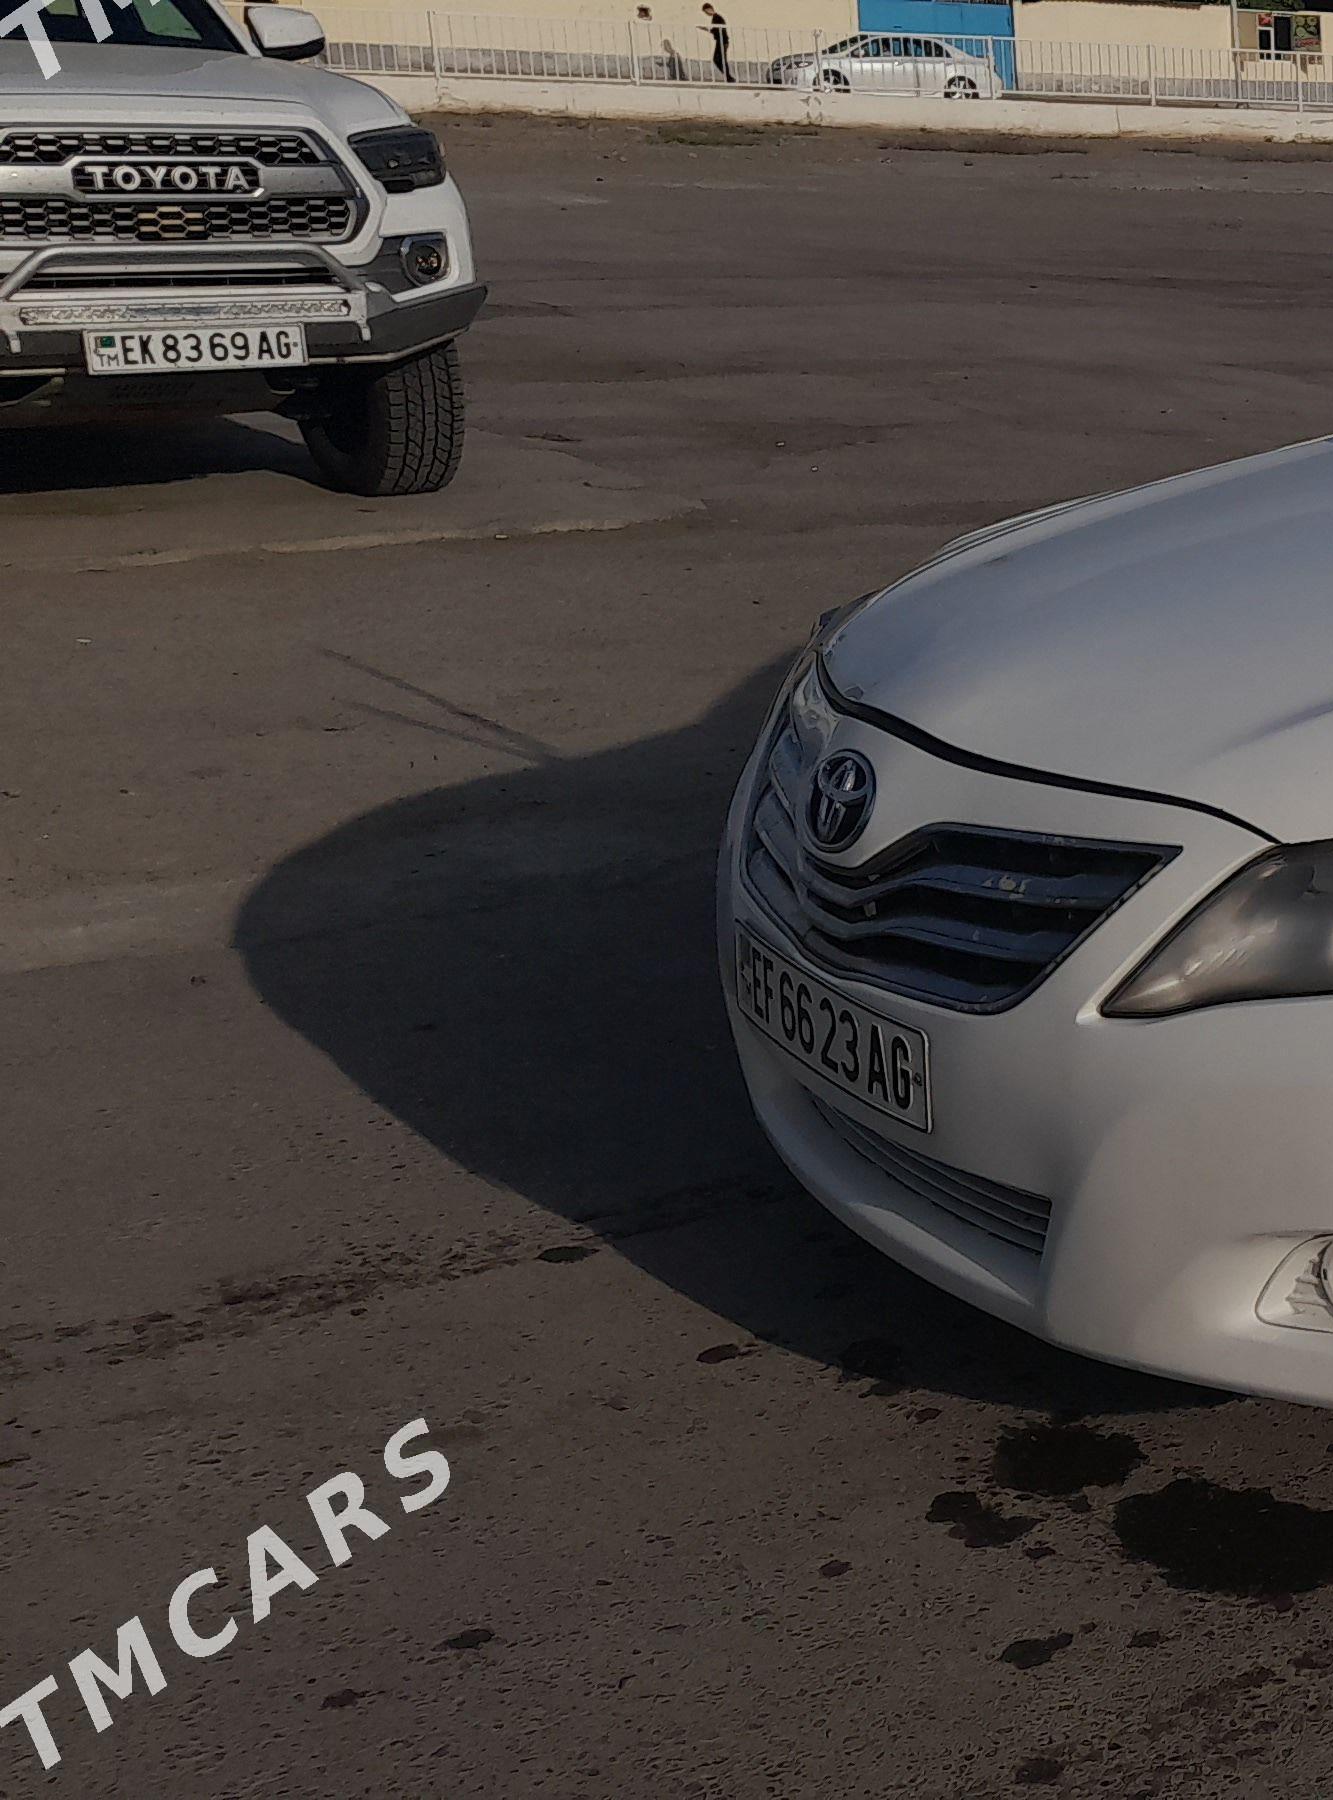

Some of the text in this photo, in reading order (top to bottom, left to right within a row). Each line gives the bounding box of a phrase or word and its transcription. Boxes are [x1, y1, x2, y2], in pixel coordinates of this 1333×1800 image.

[84, 165, 250, 191] TOYOTA
[99, 353, 120, 368] TM
[121, 334, 156, 366] EK
[257, 330, 292, 360] AG
[751, 946, 774, 1025] EF
[867, 1022, 914, 1111] AG
